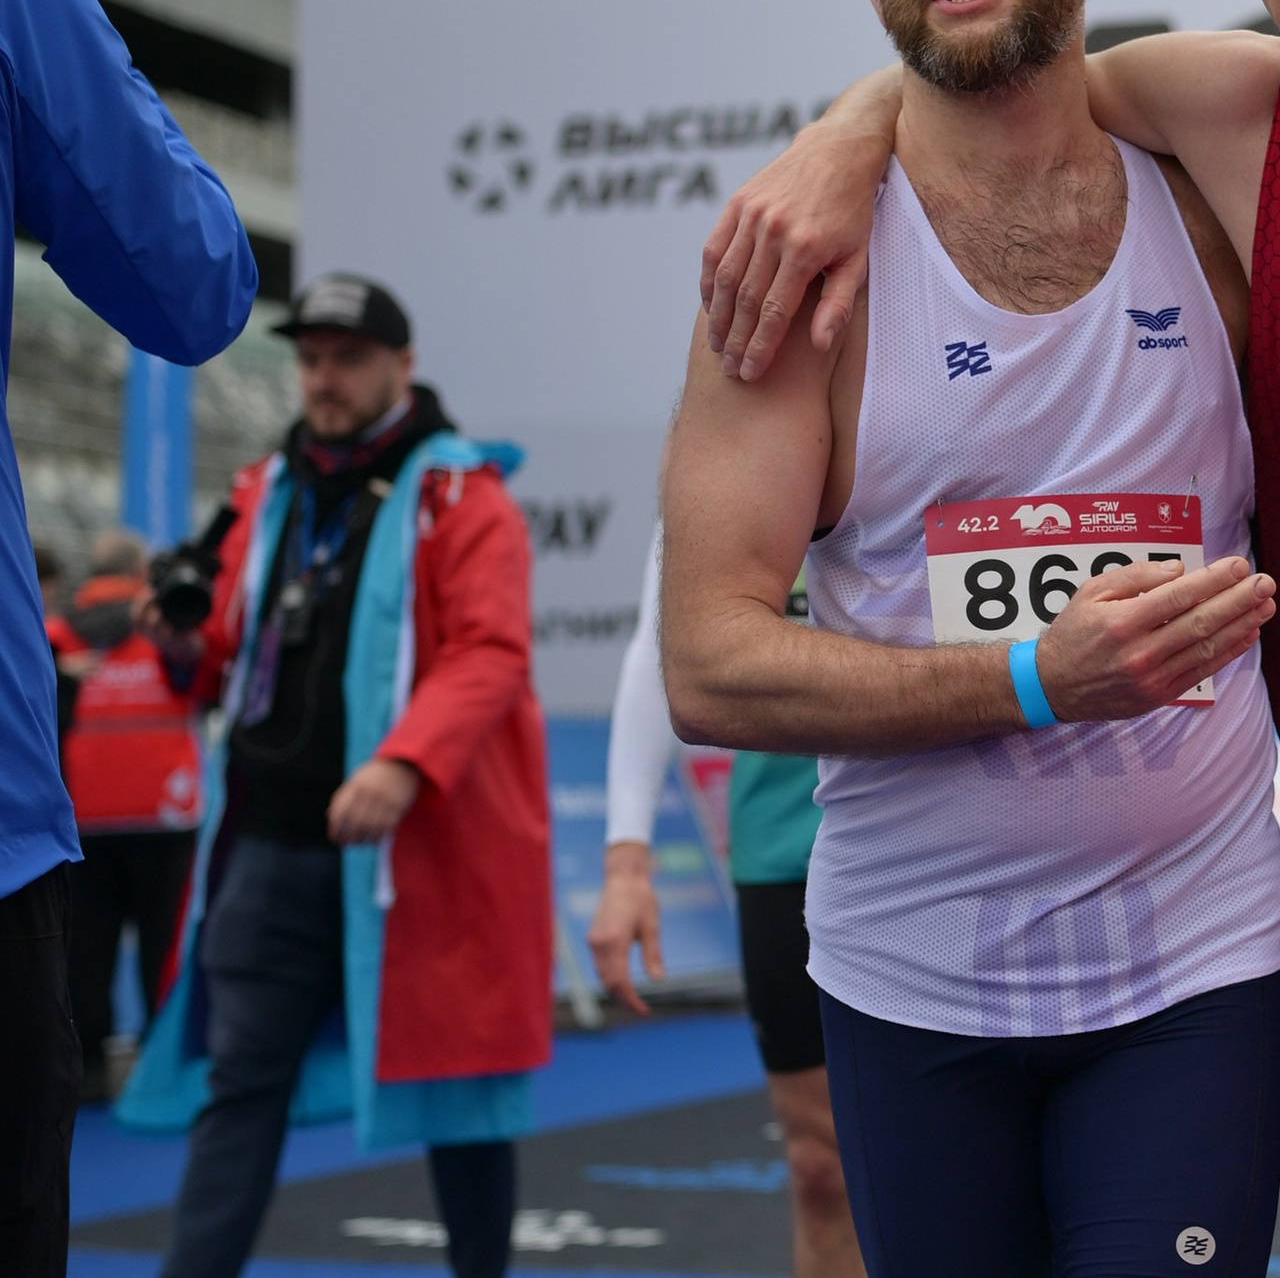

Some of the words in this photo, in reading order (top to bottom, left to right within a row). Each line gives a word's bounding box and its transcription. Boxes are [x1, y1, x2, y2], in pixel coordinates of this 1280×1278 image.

[549, 162, 719, 213] ЛИГА
[957, 516, 1000, 534] 42.2
[1079, 513, 1137, 525] SIRIUS
[1080, 525, 1138, 533] AUTODROM
[964, 551, 1182, 631] 86
